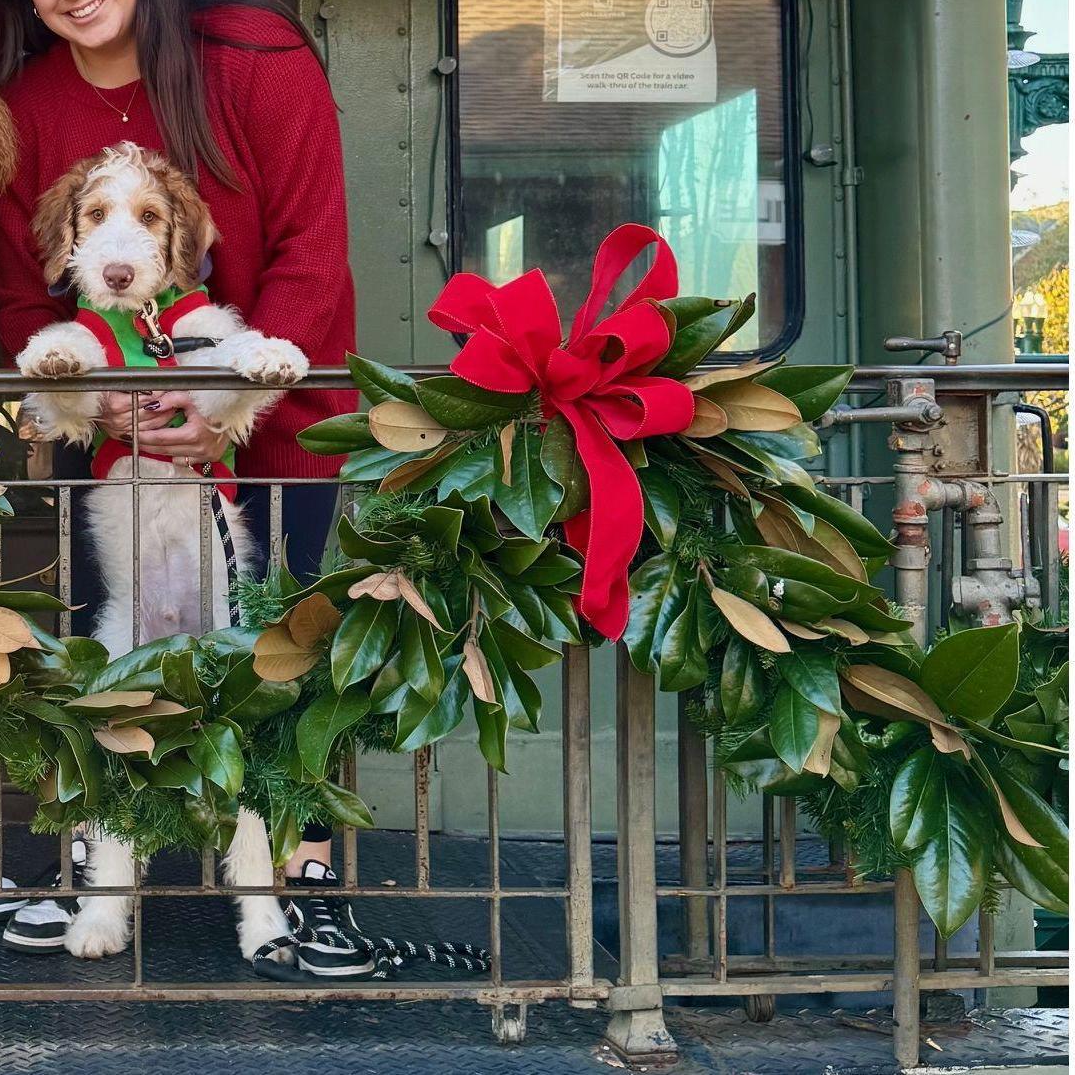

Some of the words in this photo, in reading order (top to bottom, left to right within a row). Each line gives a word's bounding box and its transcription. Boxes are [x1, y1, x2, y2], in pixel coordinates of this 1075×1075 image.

[601, 71, 615, 80] the
[617, 71, 629, 80] QR
[630, 71, 651, 80] Code
